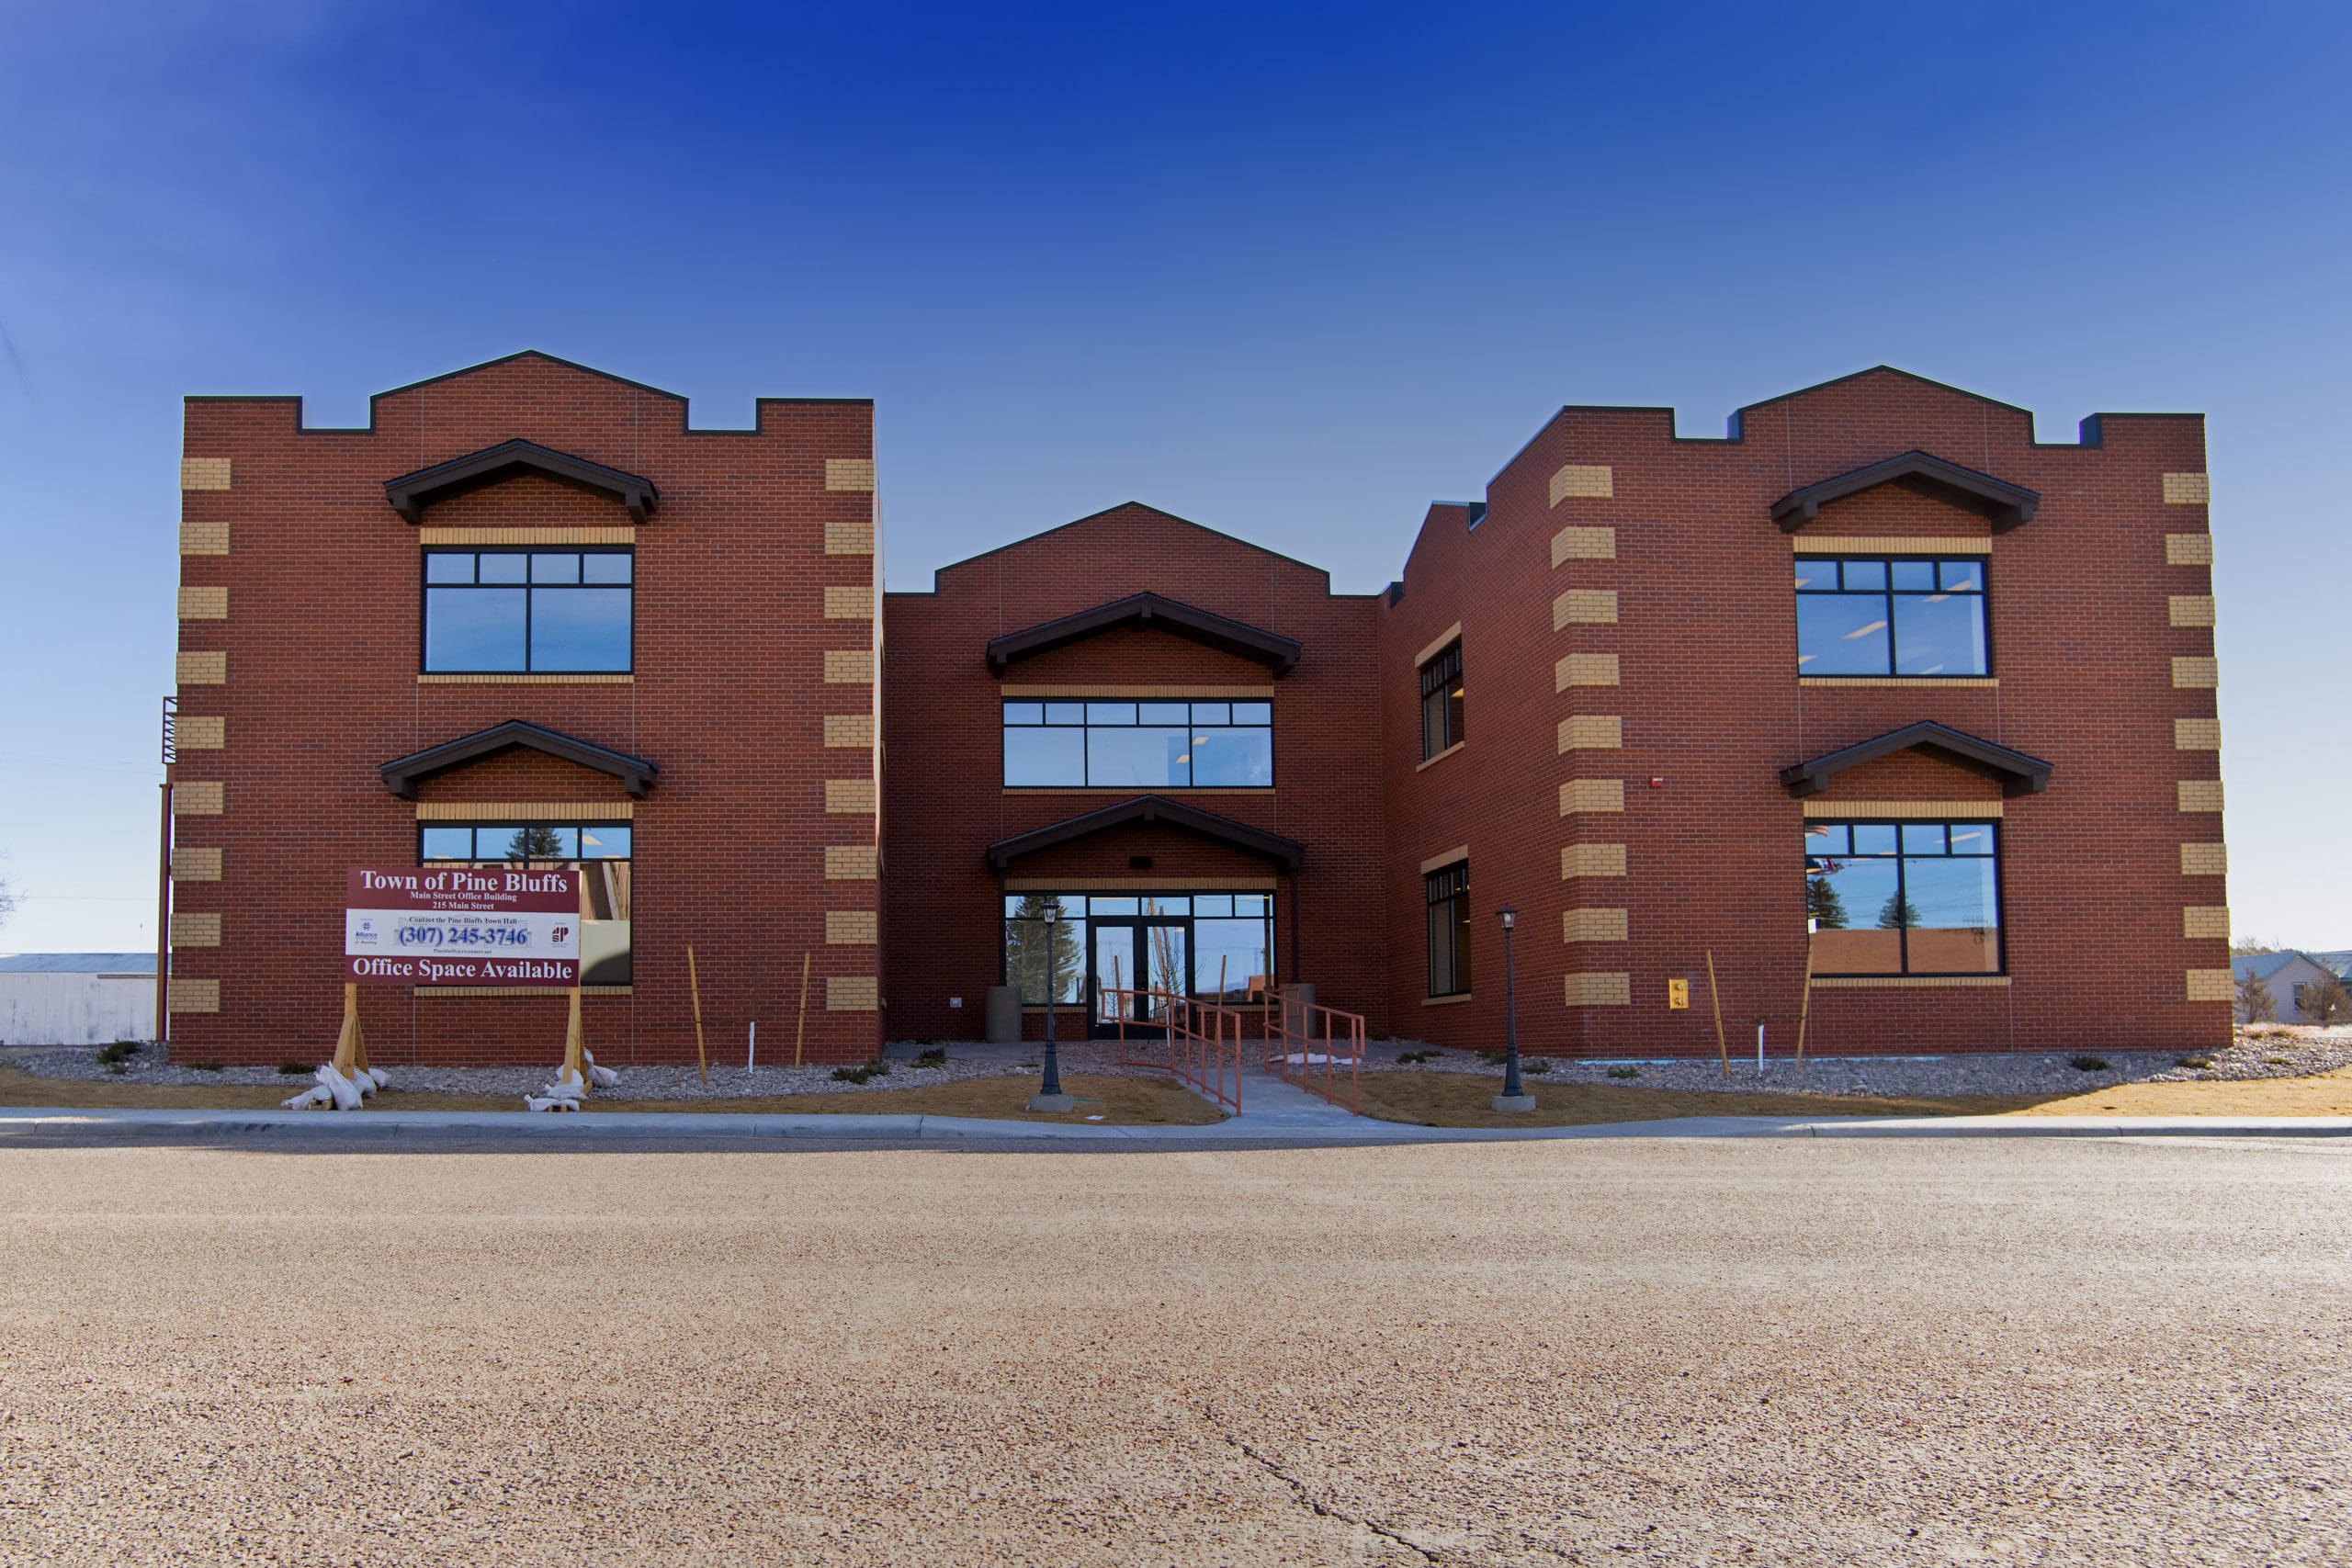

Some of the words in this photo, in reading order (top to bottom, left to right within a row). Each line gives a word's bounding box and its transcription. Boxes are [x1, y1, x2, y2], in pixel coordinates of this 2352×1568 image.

[360, 870, 417, 890] Town
[424, 871, 445, 891] of
[451, 872, 499, 892] Pine
[504, 873, 568, 893] Bluffs
[410, 891, 431, 900] Main
[433, 892, 456, 900] Street
[458, 892, 482, 901] Office
[483, 892, 517, 902] Building
[432, 901, 447, 909] 215
[448, 901, 469, 909] Main
[470, 901, 494, 910] Street
[409, 916, 436, 924] Contact
[399, 926, 444, 947] (307)
[447, 927, 527, 945] 245-3746
[352, 957, 413, 976] Office
[418, 959, 476, 980] Space
[481, 960, 572, 979] Available
